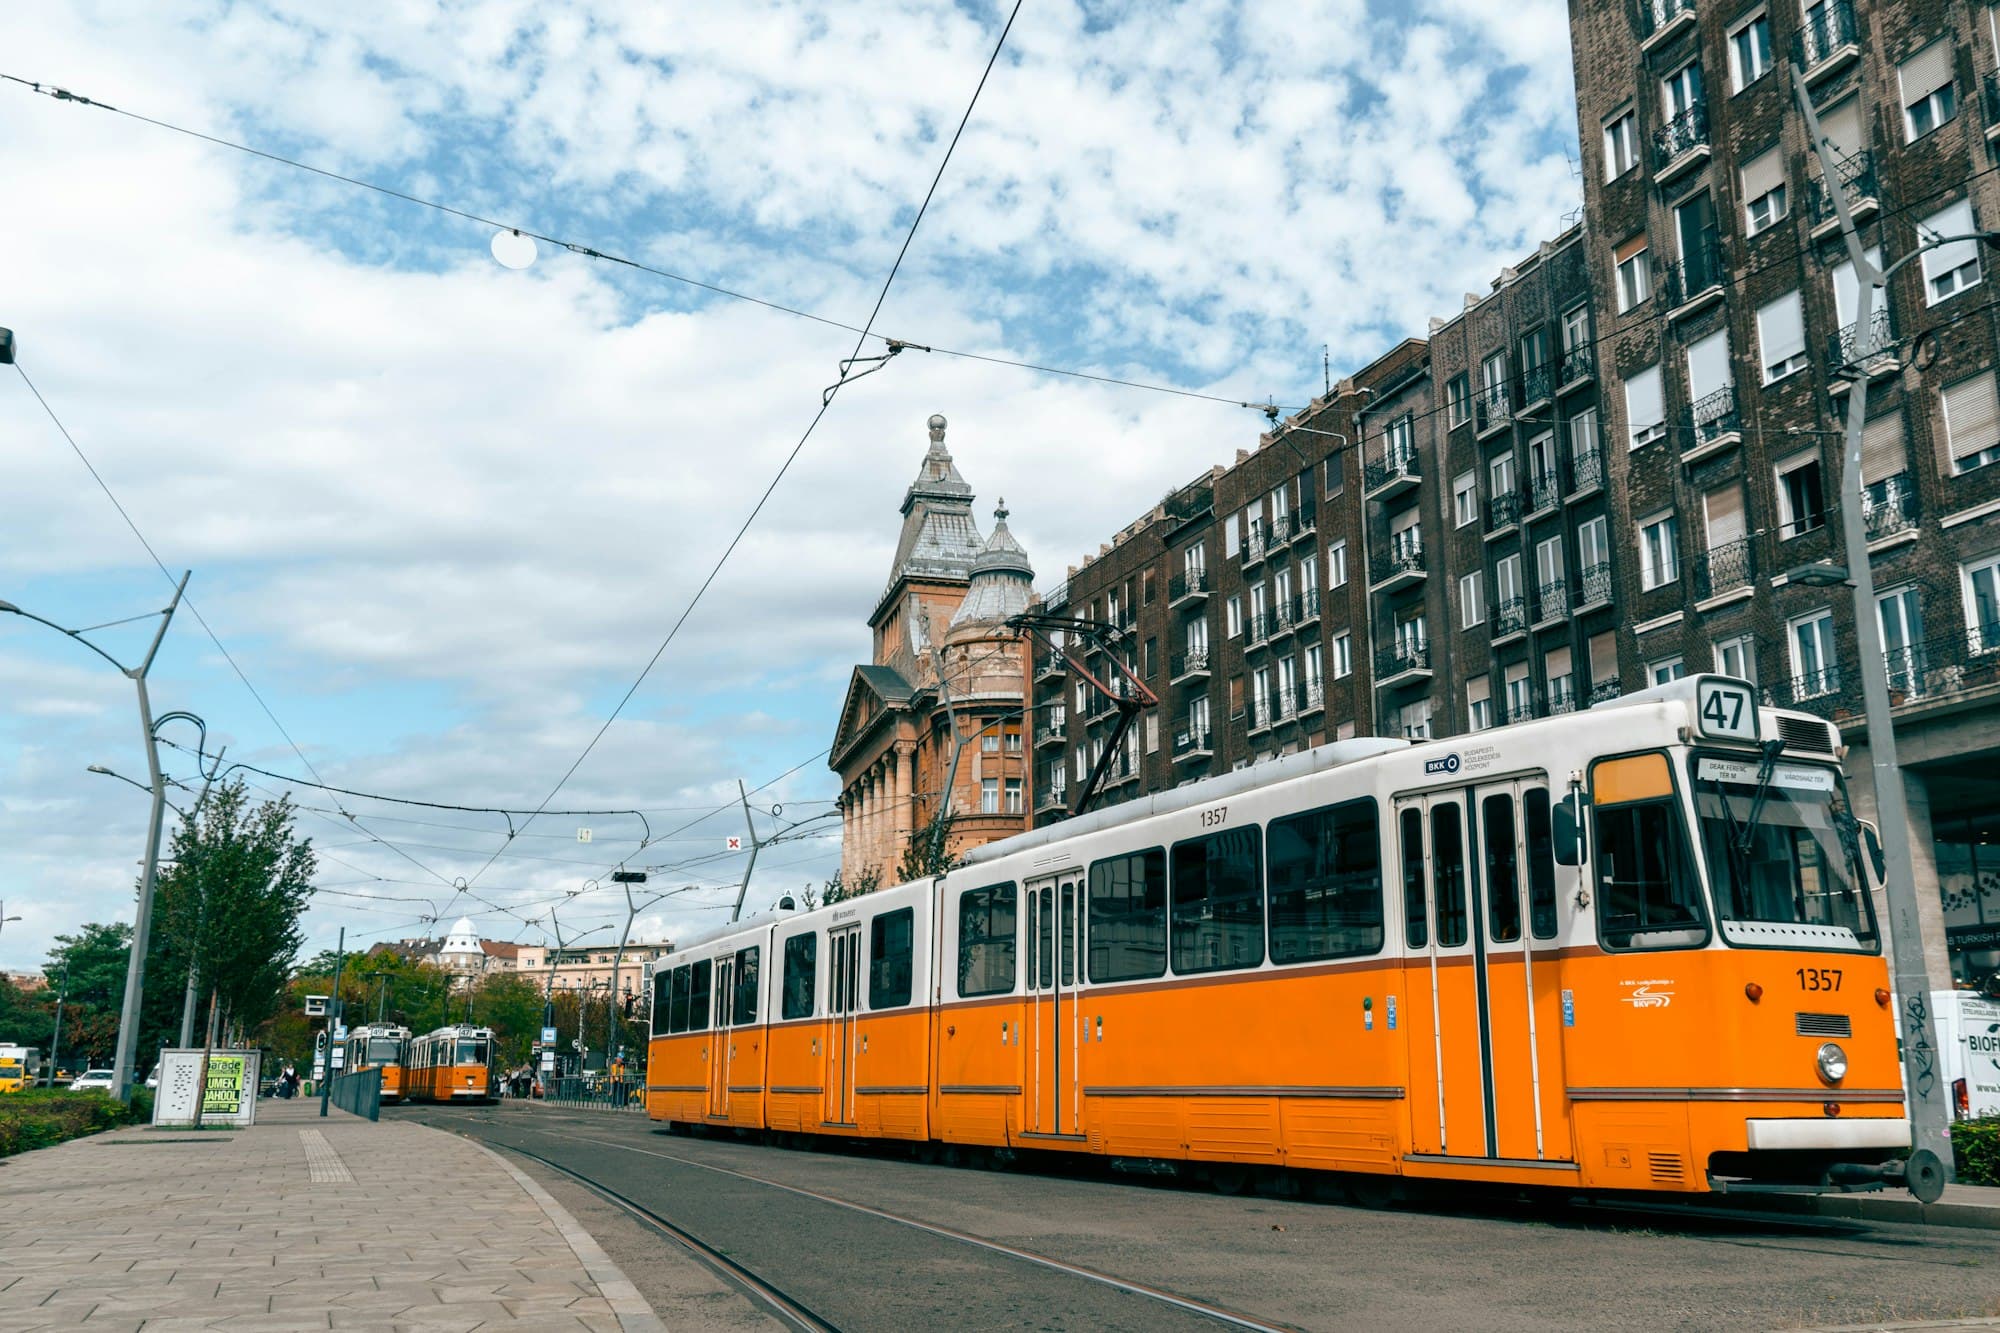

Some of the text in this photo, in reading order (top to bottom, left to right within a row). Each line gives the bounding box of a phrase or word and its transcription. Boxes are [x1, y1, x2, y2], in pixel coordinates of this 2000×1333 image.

[1703, 690, 1744, 730] 47
[1464, 747, 1494, 756] BUDAPESTI
[1428, 762, 1445, 771] BKK
[1200, 806, 1228, 827] 1357
[1955, 933, 1994, 944] TURKISH
[1796, 968, 1843, 991] 1357
[373, 1028, 383, 1036] 49
[461, 1028, 470, 1036] 47
[208, 1078, 235, 1089] UMEK
